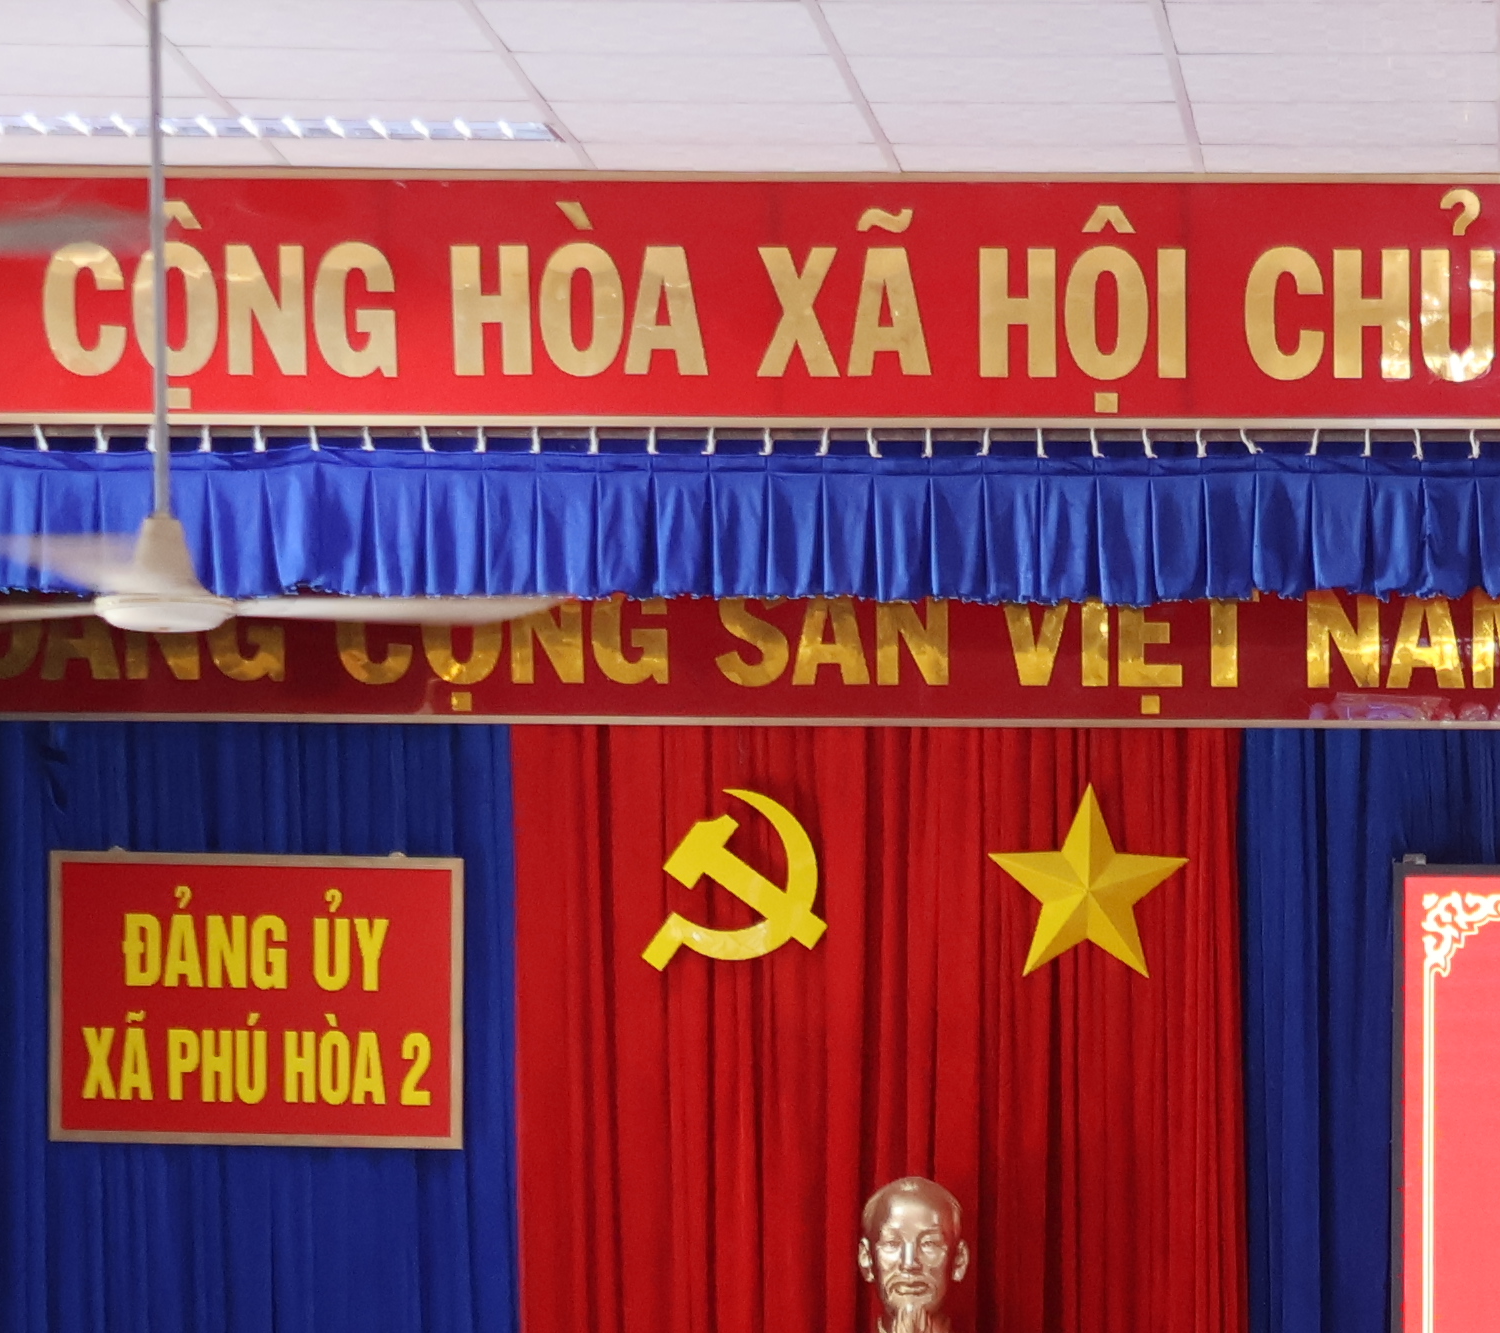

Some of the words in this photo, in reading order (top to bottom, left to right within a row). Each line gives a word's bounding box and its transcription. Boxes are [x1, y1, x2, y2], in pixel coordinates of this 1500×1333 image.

[43, 199, 398, 410] CỘNG
[449, 201, 709, 377] HÒA
[757, 208, 932, 378] XÃ
[979, 205, 1187, 413] HỘI
[1245, 189, 1496, 381] CHỦ
[123, 886, 287, 989] ĐẢNG
[314, 889, 389, 991] ỦY
[83, 1010, 153, 1100] XÃ
[168, 1013, 267, 1104] PHÚ
[285, 1014, 385, 1104] HÒA
[401, 1032, 430, 1105] 2
